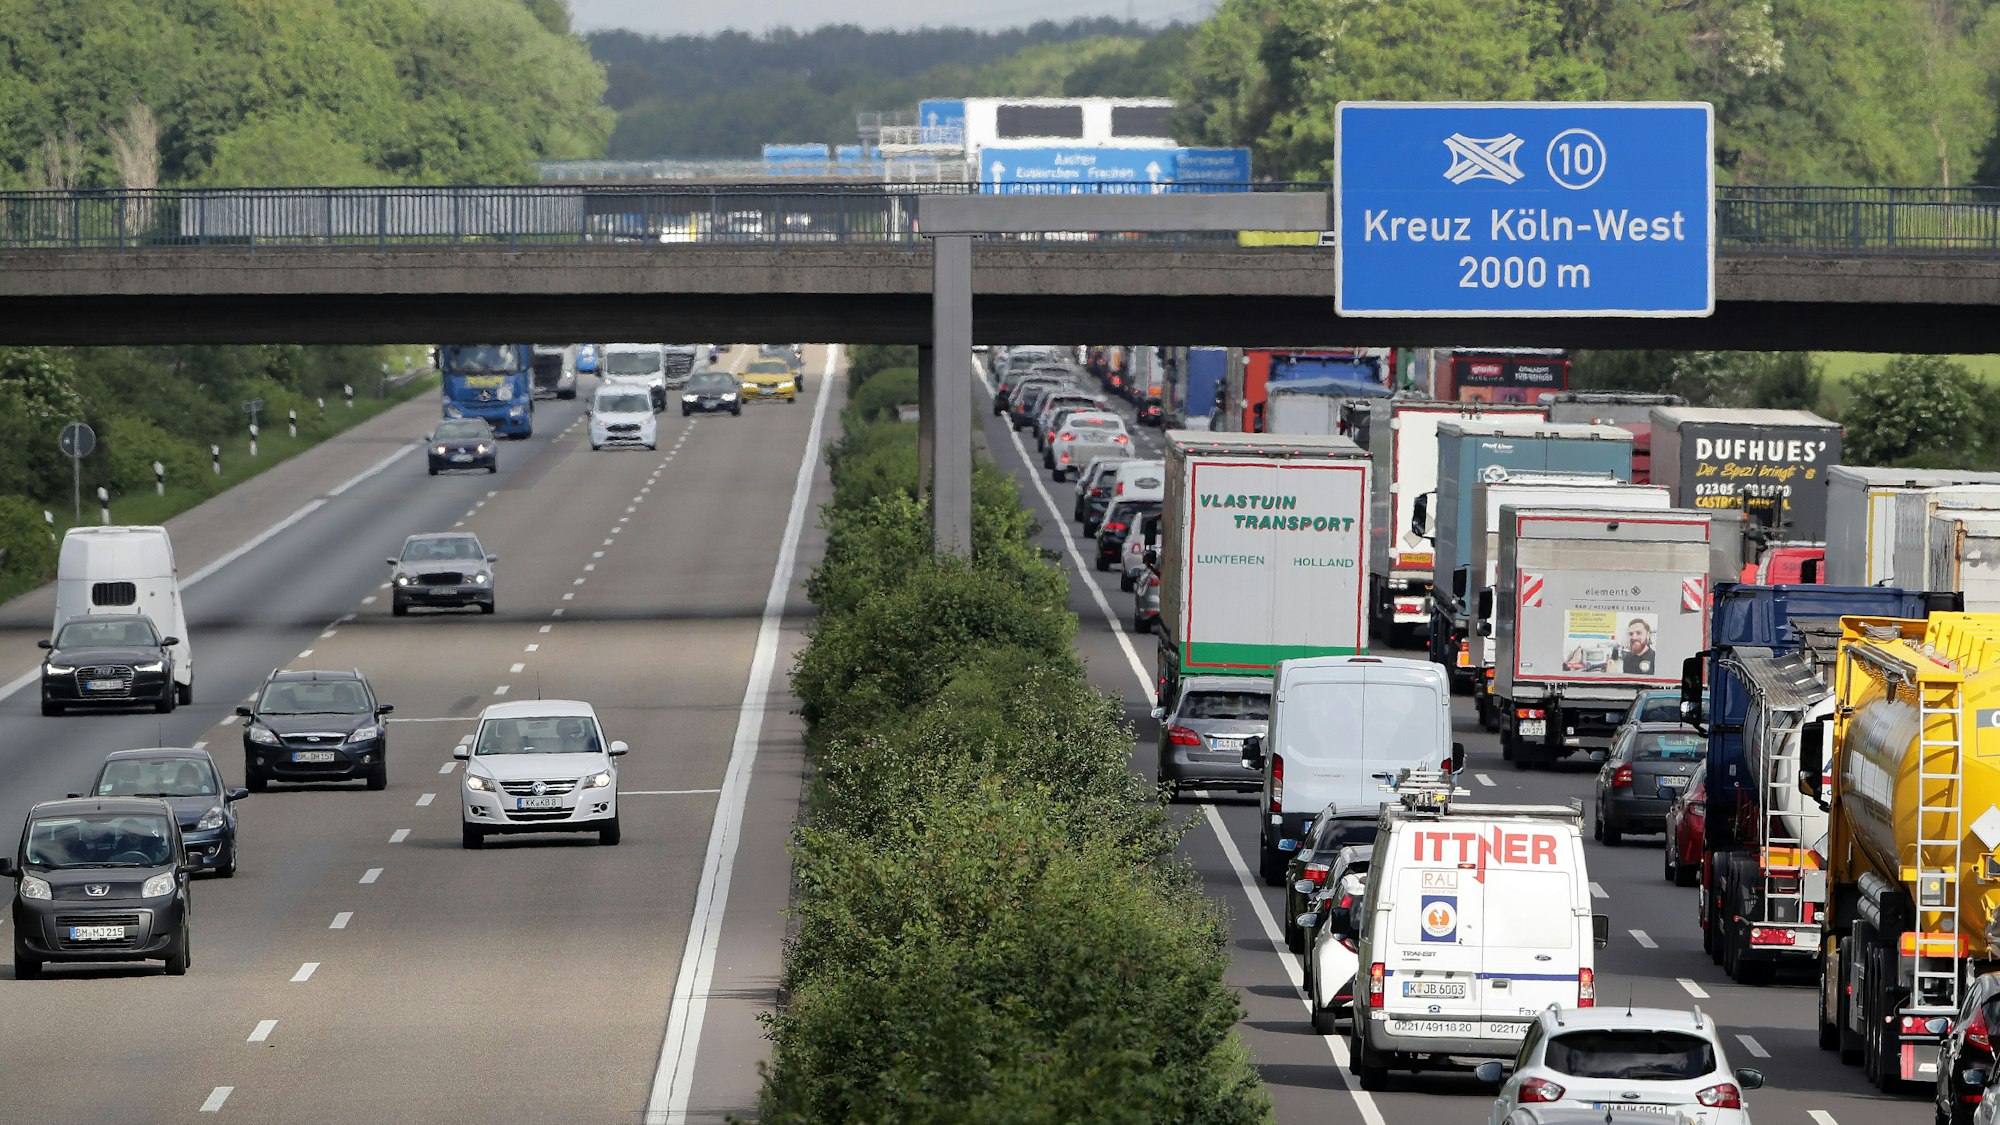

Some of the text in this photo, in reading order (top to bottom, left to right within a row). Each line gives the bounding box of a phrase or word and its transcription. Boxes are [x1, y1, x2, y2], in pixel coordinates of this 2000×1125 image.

[1558, 143, 1594, 175] 10
[1364, 207, 1685, 242] Kreuz Köln-West
[1459, 256, 1591, 288] 2000 m
[1696, 462, 1718, 477] Der
[1720, 462, 1758, 480] Spezi
[1695, 483, 1735, 495] 02305
[1200, 494, 1297, 510] VLASTUIN
[1233, 515, 1355, 532] TRANSPORT
[1197, 554, 1354, 568] LUNTEREN HOLLAND
[1585, 588, 1628, 596] elements
[1414, 825, 1557, 880] ITTNER
[1424, 872, 1455, 887] RAL
[76, 927, 123, 937] BM MJ 215
[1410, 983, 1464, 995] K JB 6003
[1519, 1007, 1537, 1016] Fax
